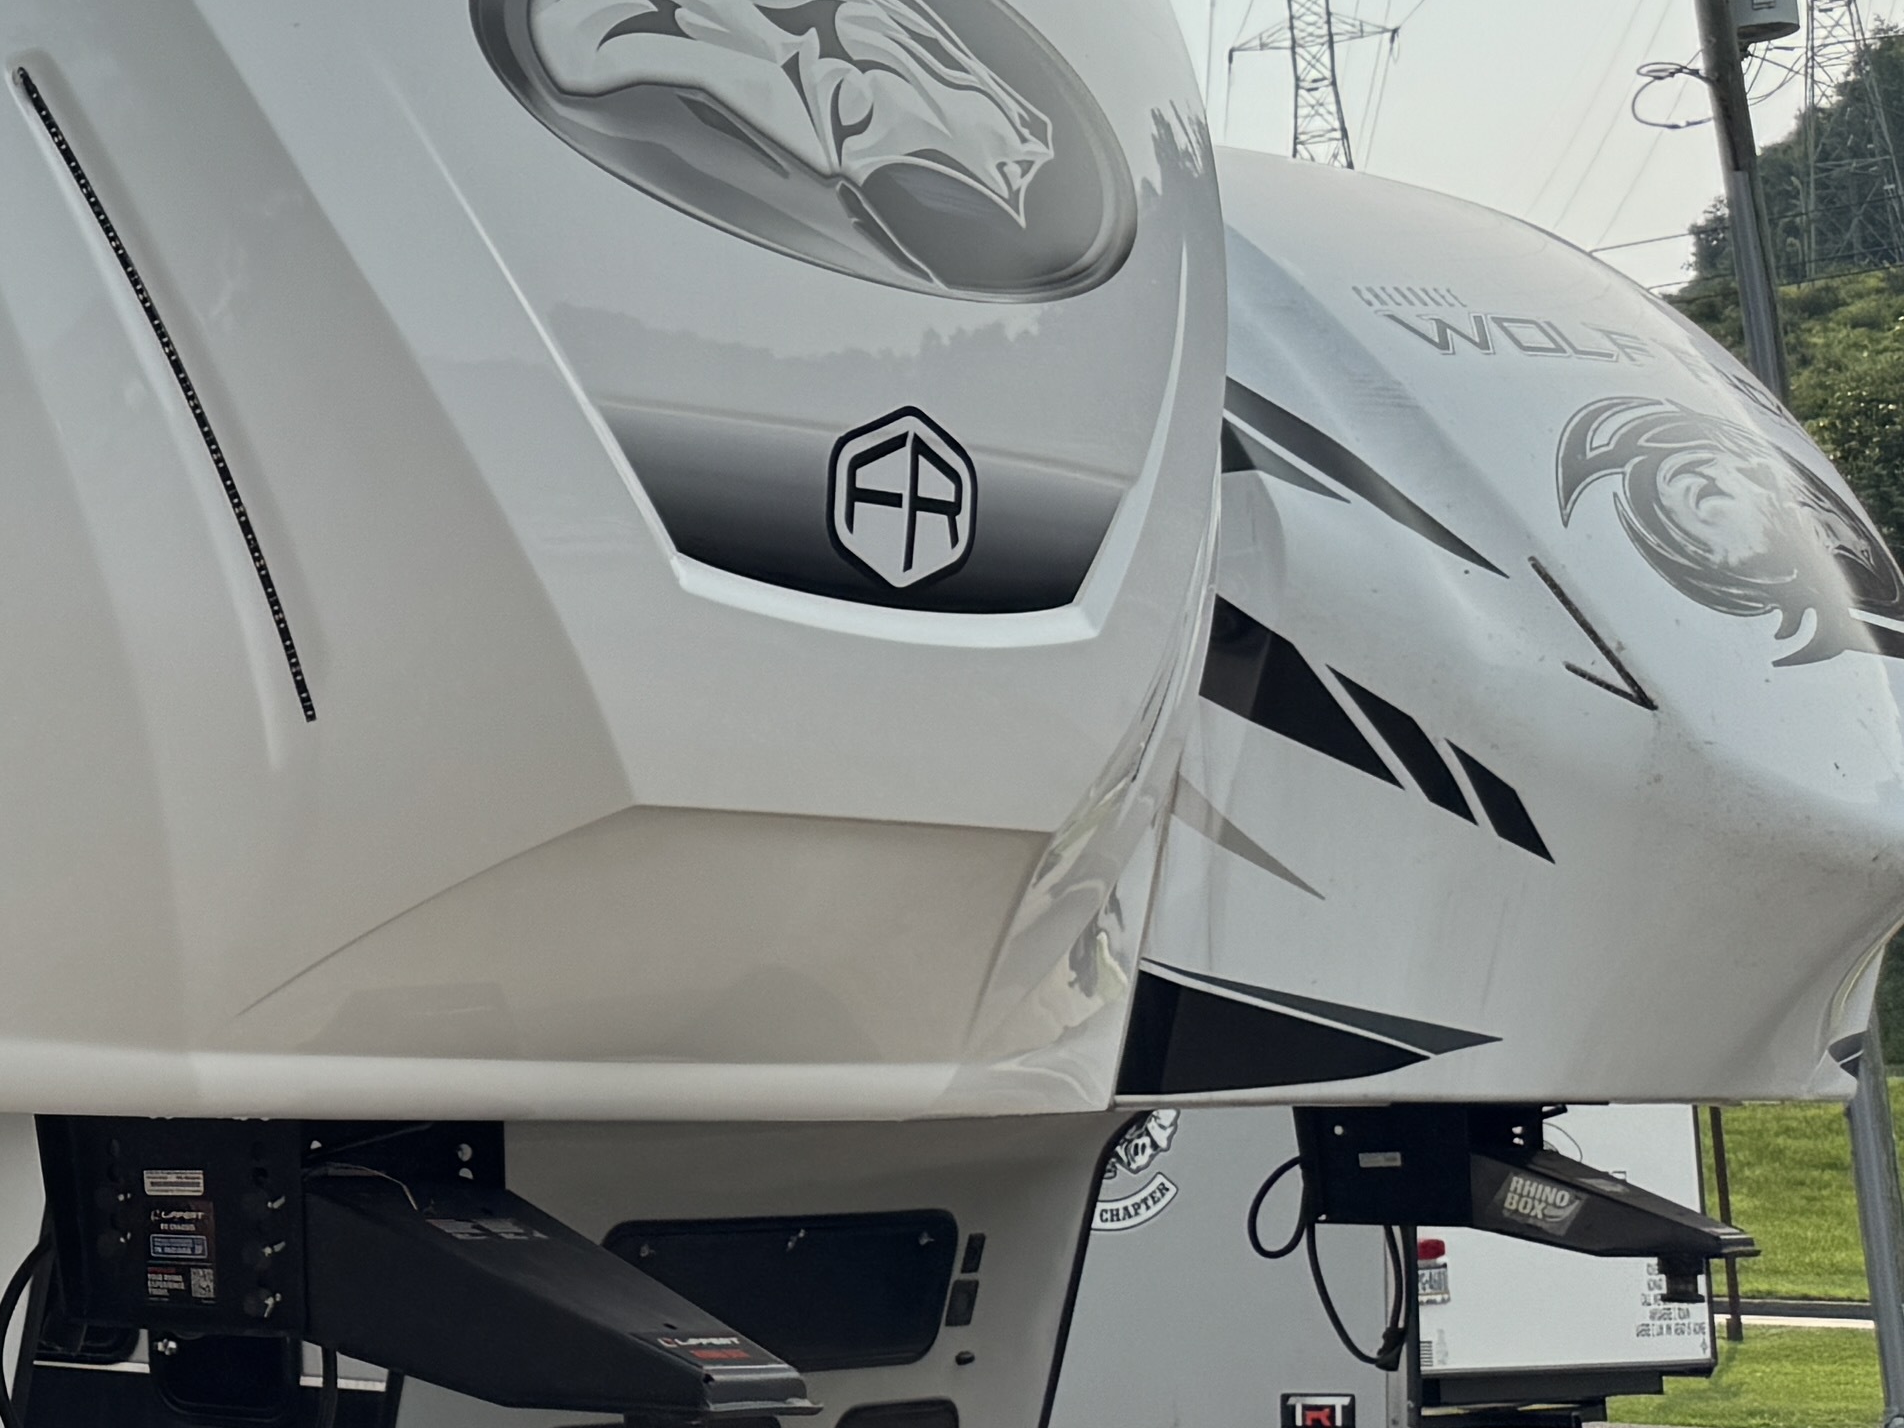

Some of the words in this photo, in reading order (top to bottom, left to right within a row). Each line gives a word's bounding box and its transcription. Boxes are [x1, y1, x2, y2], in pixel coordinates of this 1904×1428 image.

[1375, 309, 1656, 367] WOLF
[1098, 1181, 1171, 1224] CHAPTER
[1503, 1191, 1547, 1220] BOX
[1509, 1175, 1571, 1208] RHINO
